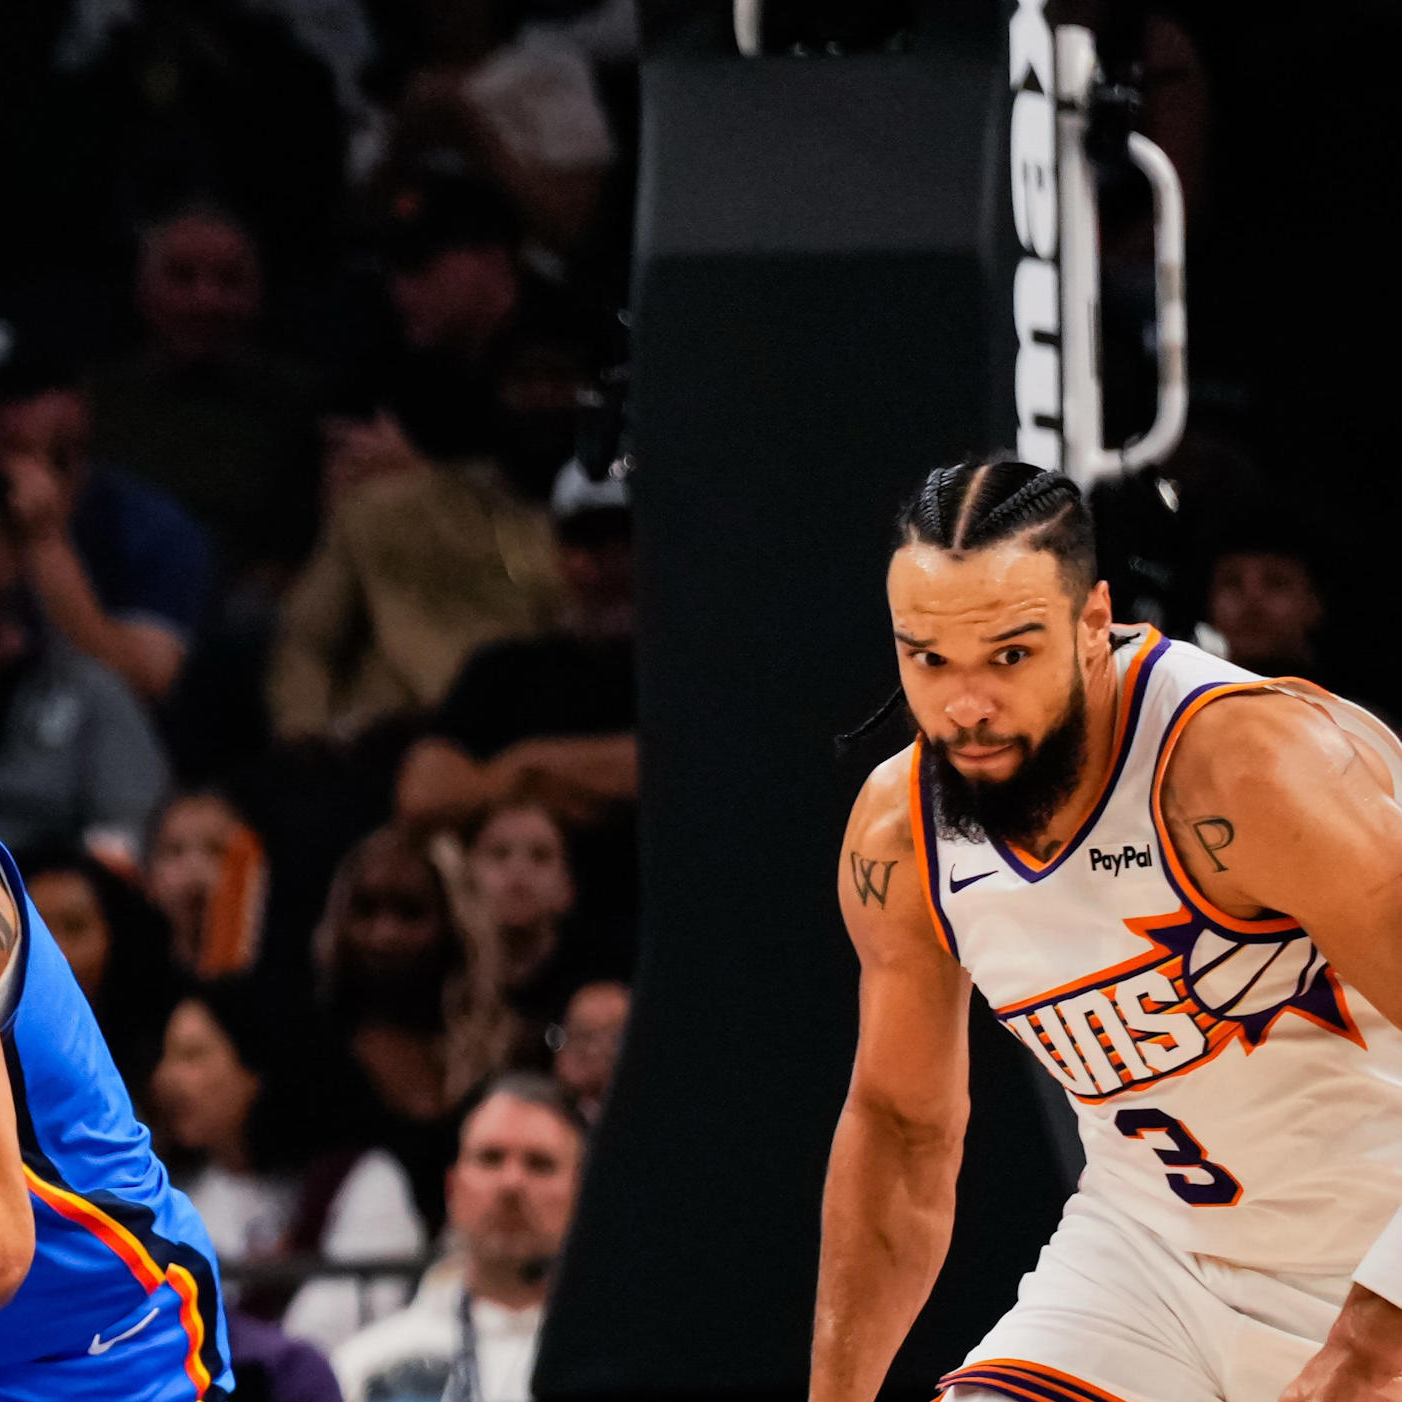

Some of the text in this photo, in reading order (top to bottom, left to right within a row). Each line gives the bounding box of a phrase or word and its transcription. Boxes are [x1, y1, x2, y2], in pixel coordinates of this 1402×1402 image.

[1089, 844, 1153, 877] PayPal
[1006, 970, 1210, 1097] UNS
[1114, 1108, 1244, 1207] 3
